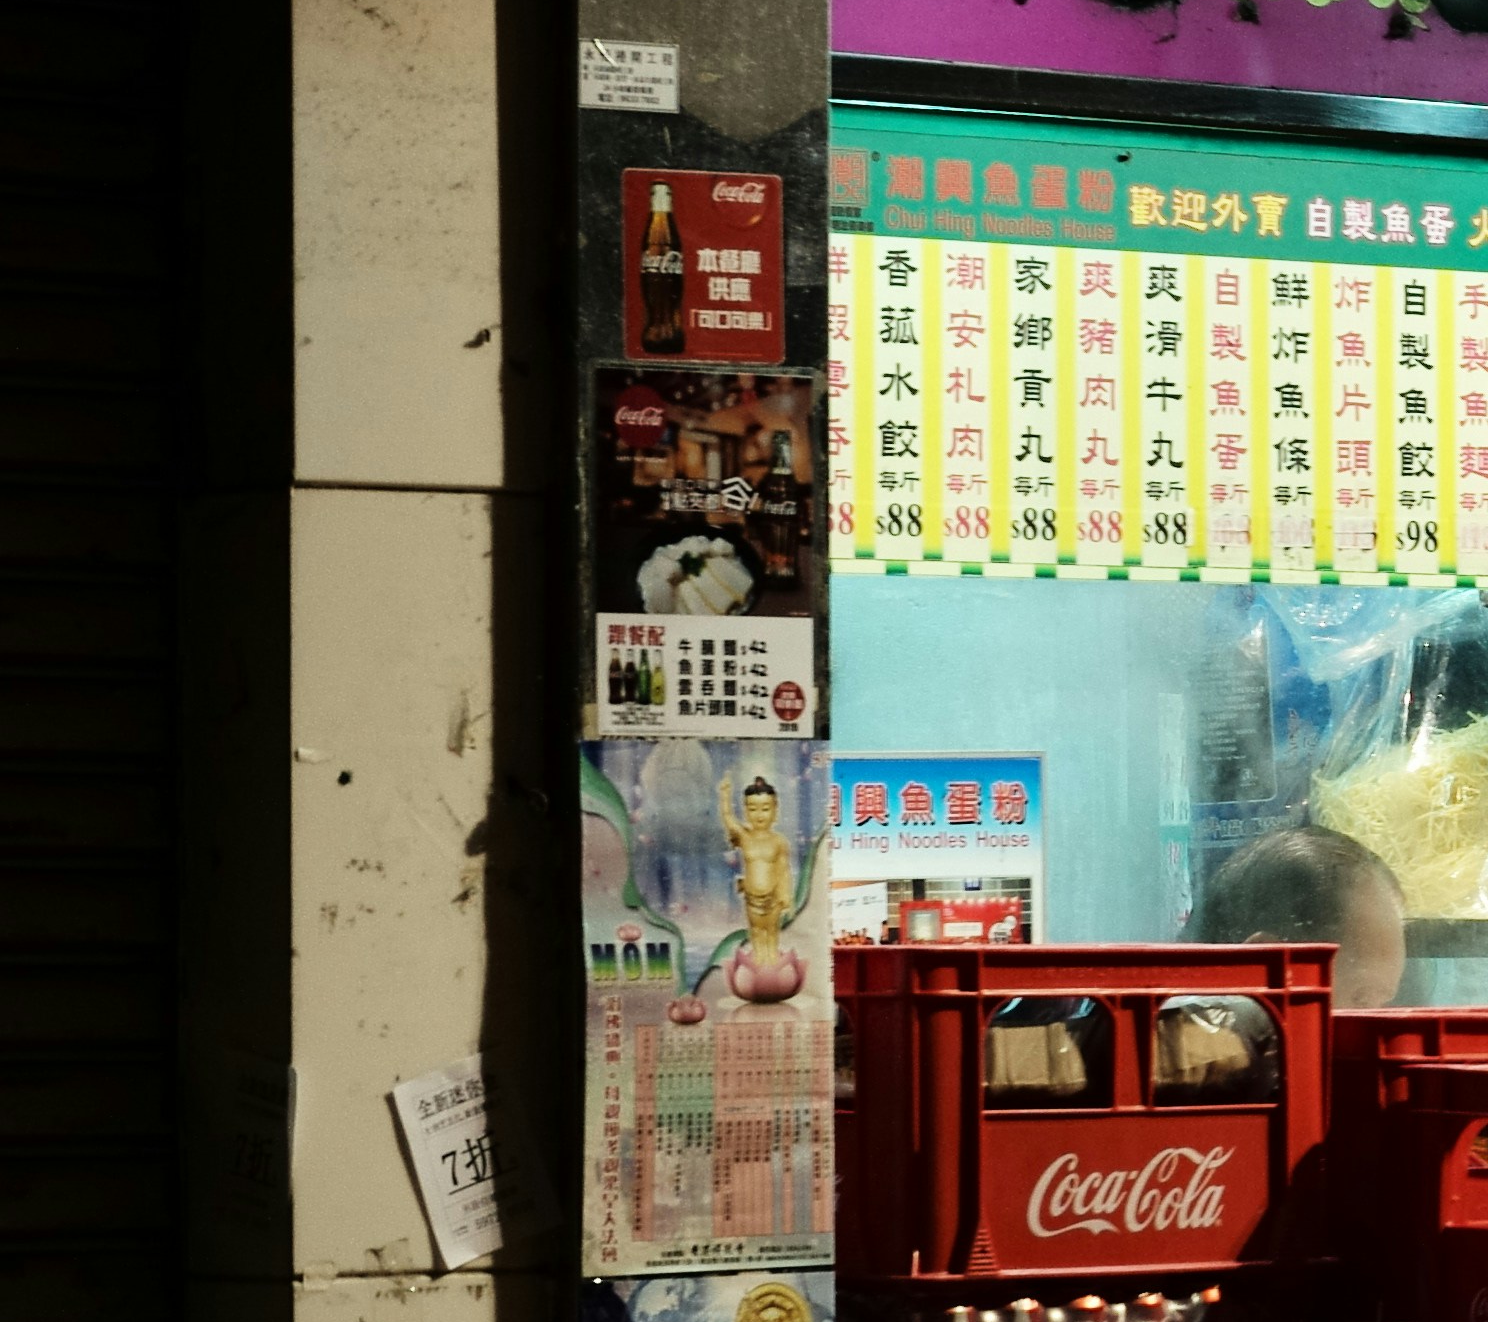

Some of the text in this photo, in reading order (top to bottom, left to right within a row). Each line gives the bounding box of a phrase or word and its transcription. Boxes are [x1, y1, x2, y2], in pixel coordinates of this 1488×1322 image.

[712, 181, 766, 204] Coca-Cola
[886, 156, 1114, 211] 潮興魚蛋粉
[884, 206, 1114, 242] Chui Hing Noodles House
[1128, 185, 1287, 237] 歡迎外賣
[1306, 199, 1455, 245] 自製魚蛋
[851, 831, 1030, 853] Hing Noodles House
[1027, 1146, 1235, 1238] Coca-Cola
